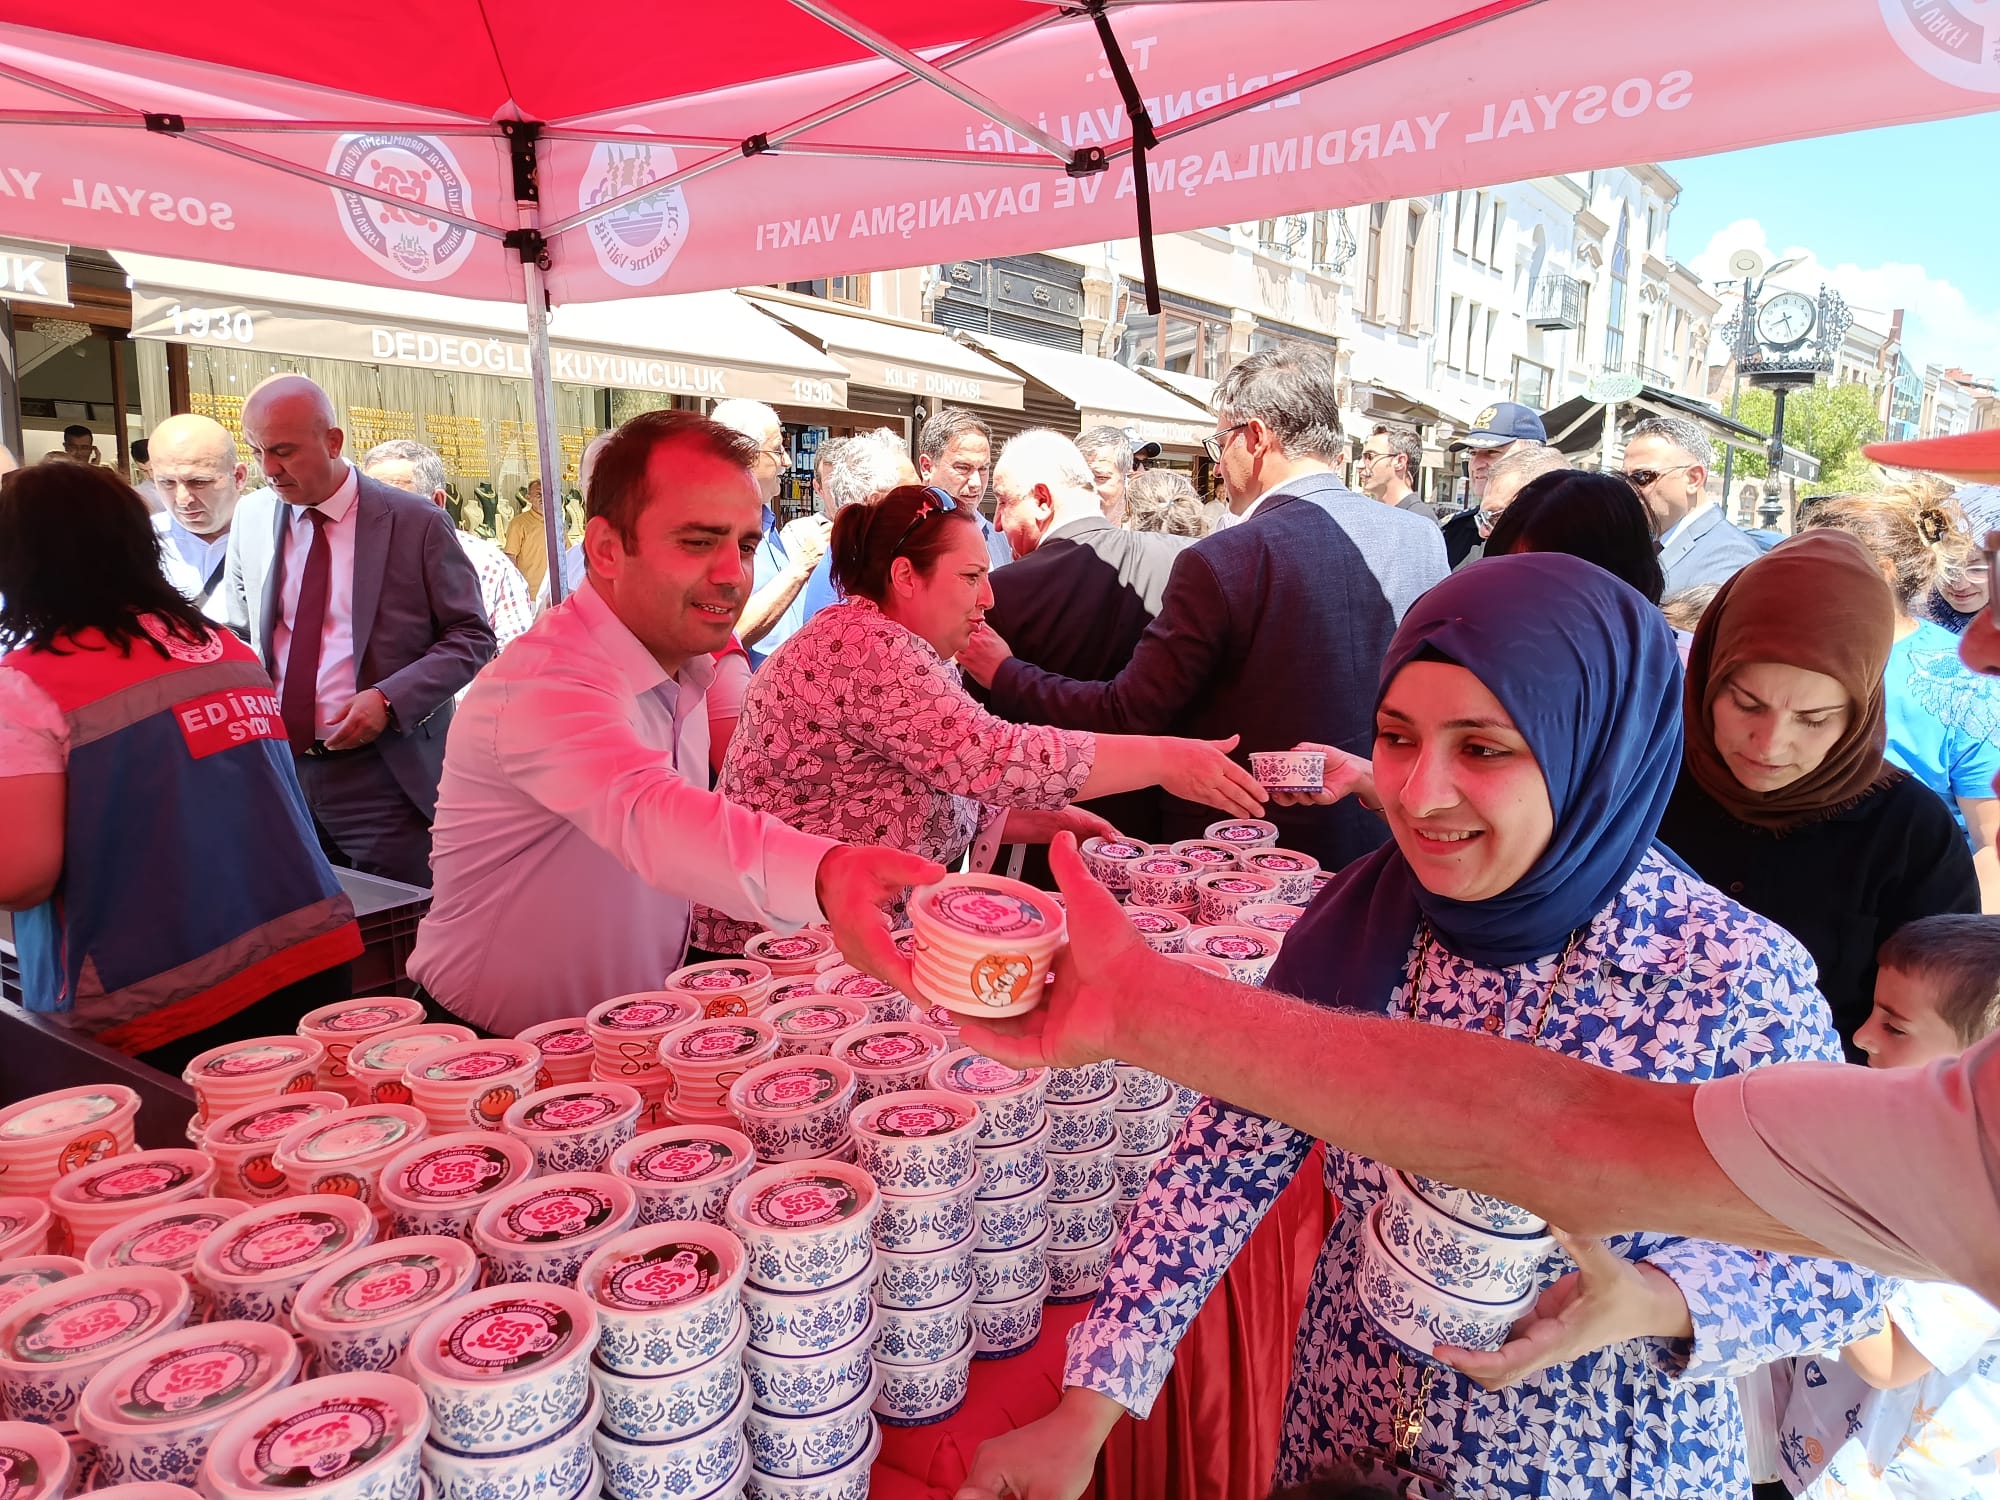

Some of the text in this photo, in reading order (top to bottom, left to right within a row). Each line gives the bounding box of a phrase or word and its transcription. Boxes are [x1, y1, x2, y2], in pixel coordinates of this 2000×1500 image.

[166, 304, 254, 343] 1930
[556, 350, 727, 394] KUYUMCULUK
[791, 379, 833, 404] 1930
[884, 367, 919, 390] KILIF
[181, 693, 281, 733] EDİRNE
